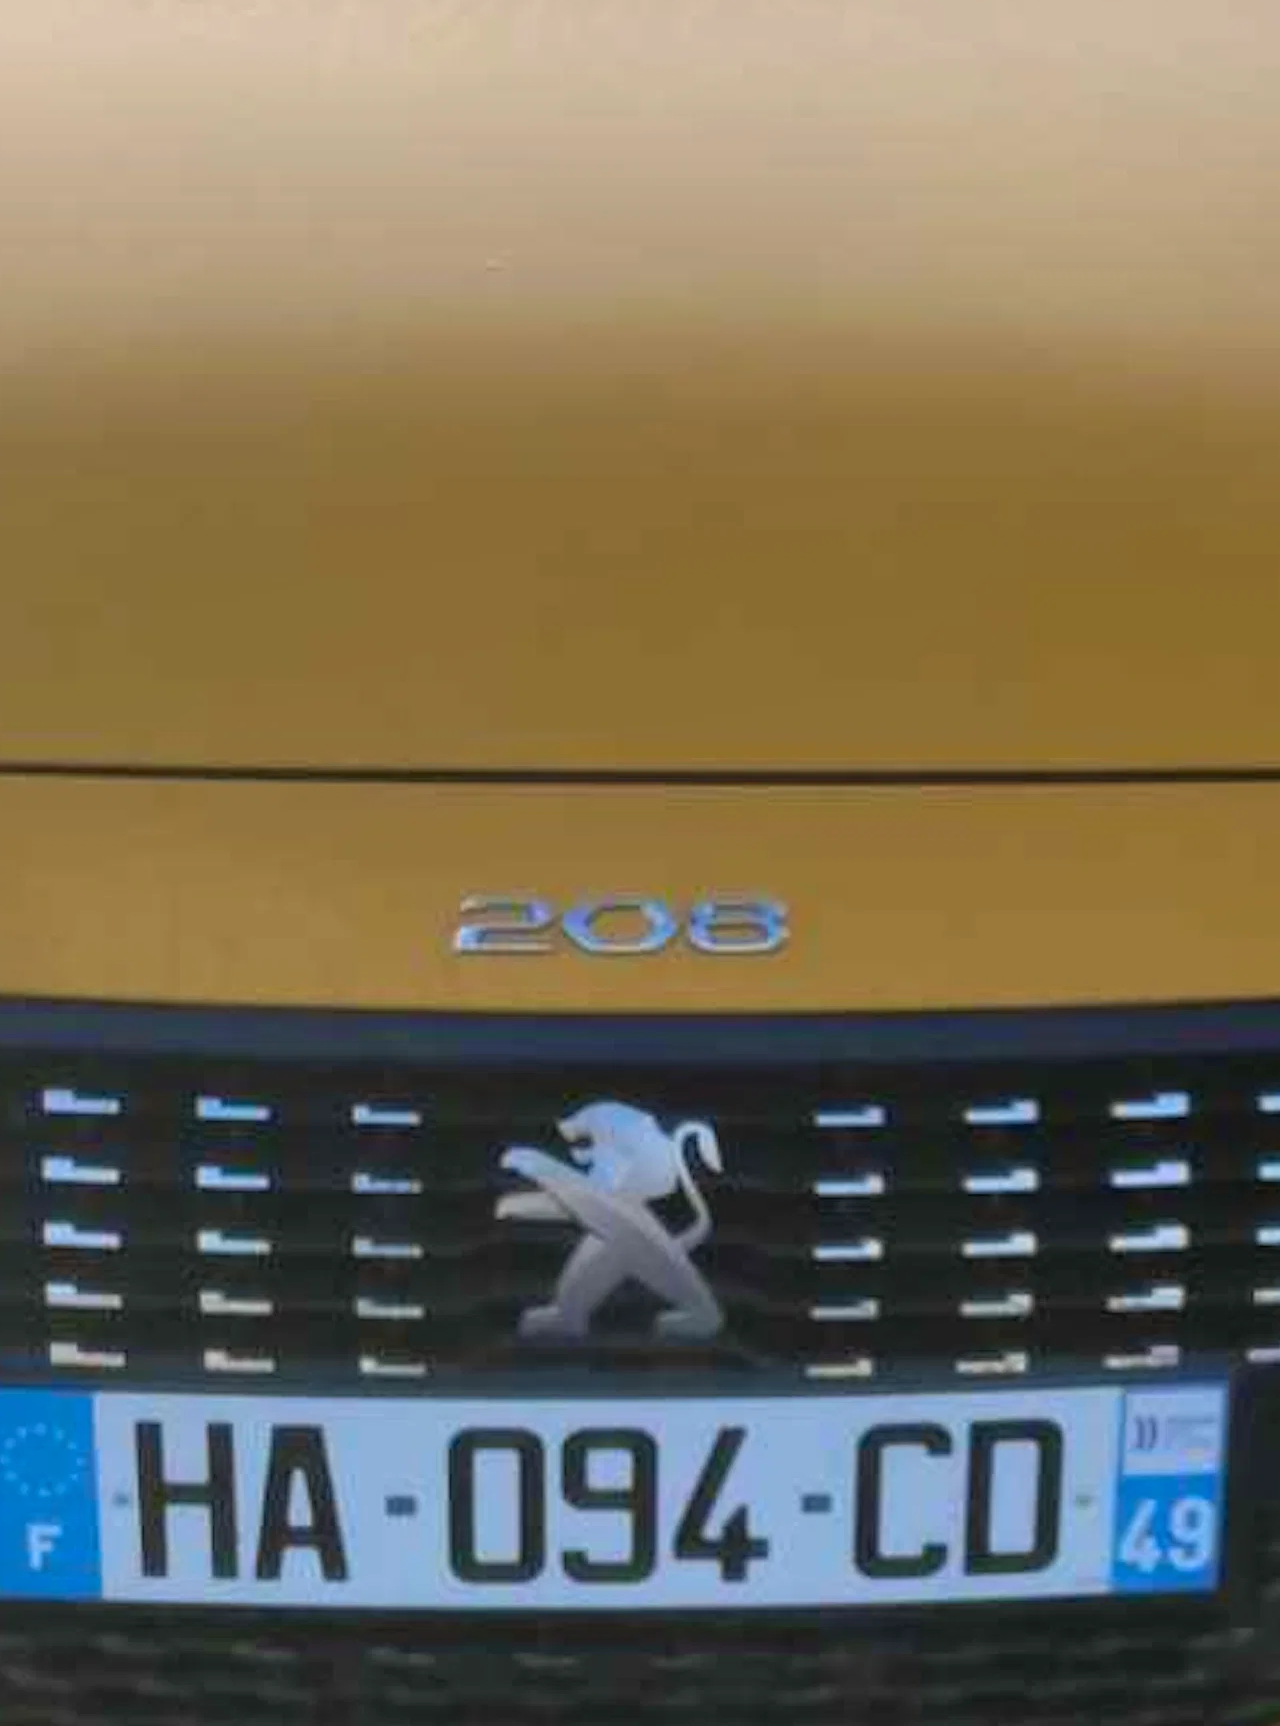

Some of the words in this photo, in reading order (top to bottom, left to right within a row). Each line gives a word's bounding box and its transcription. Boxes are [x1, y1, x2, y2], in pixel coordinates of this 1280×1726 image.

[454, 896, 790, 954] 208
[134, 1419, 1065, 1585] HA-094-CD
[1122, 1496, 1215, 1573] 49
[26, 1522, 62, 1570] F
